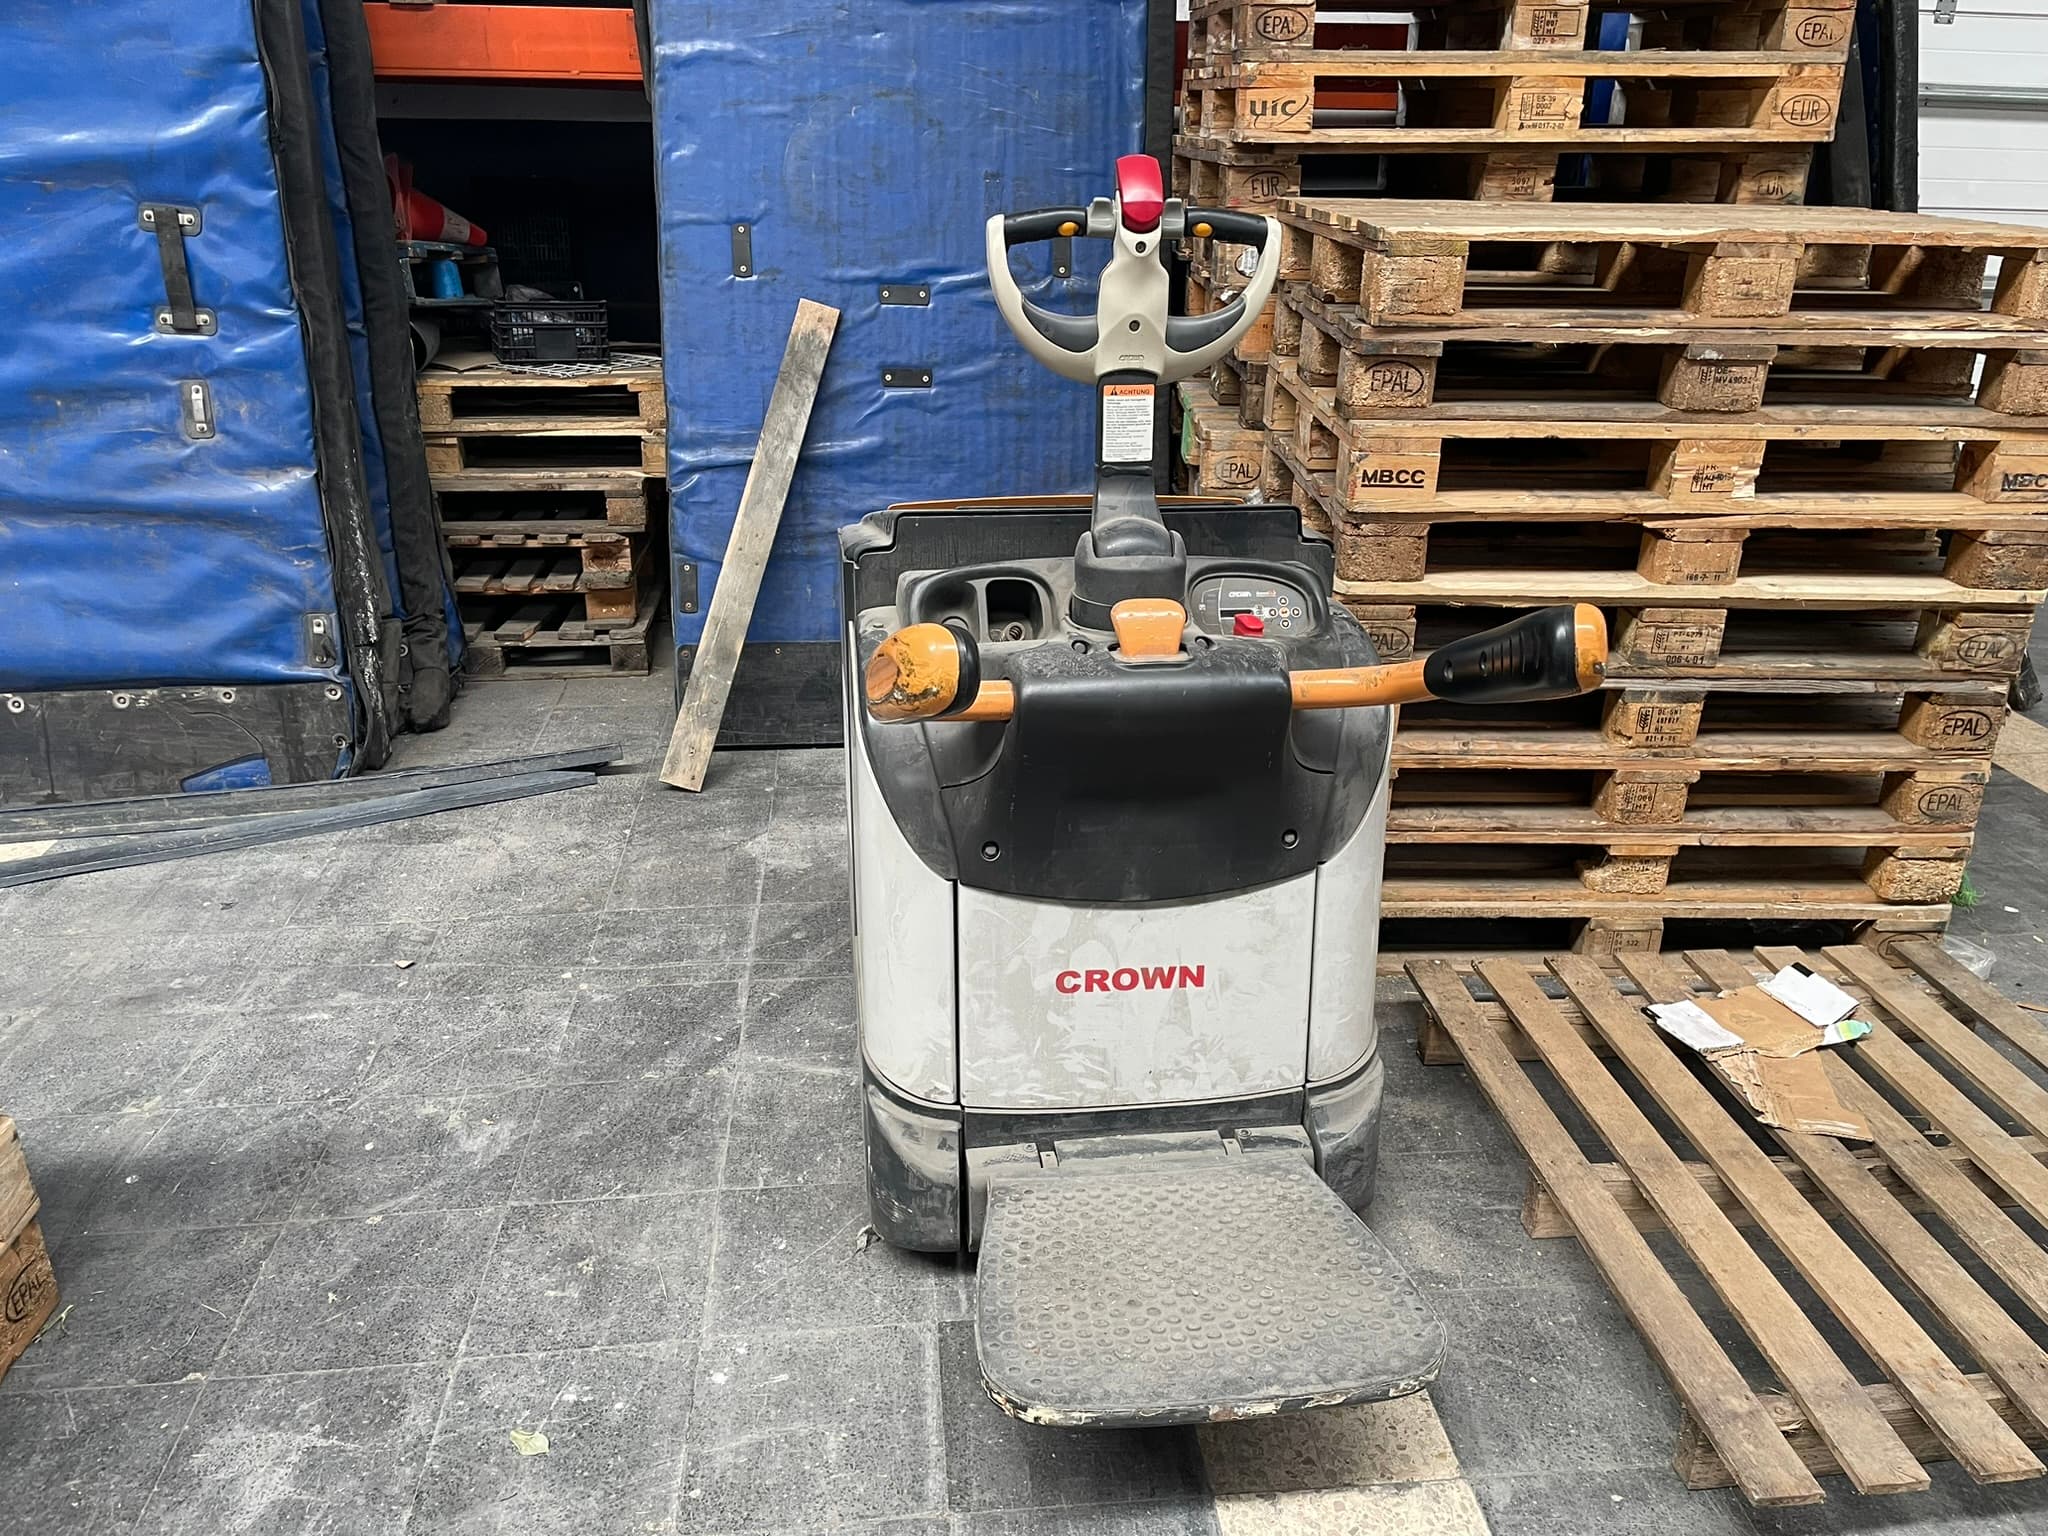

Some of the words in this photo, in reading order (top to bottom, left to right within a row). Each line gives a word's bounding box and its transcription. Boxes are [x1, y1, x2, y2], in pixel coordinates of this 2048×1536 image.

[1790, 100, 1820, 121] EUR
[1371, 369, 1413, 392] EPAL
[1221, 462, 1254, 479] EPAL
[1361, 469, 1426, 484] MBCC
[1369, 633, 1400, 651] PAL
[1965, 640, 2004, 659] EPAL
[1943, 718, 1982, 736] EPAL
[1927, 794, 1967, 811] EPAL
[1055, 965, 1205, 994] CROWN
